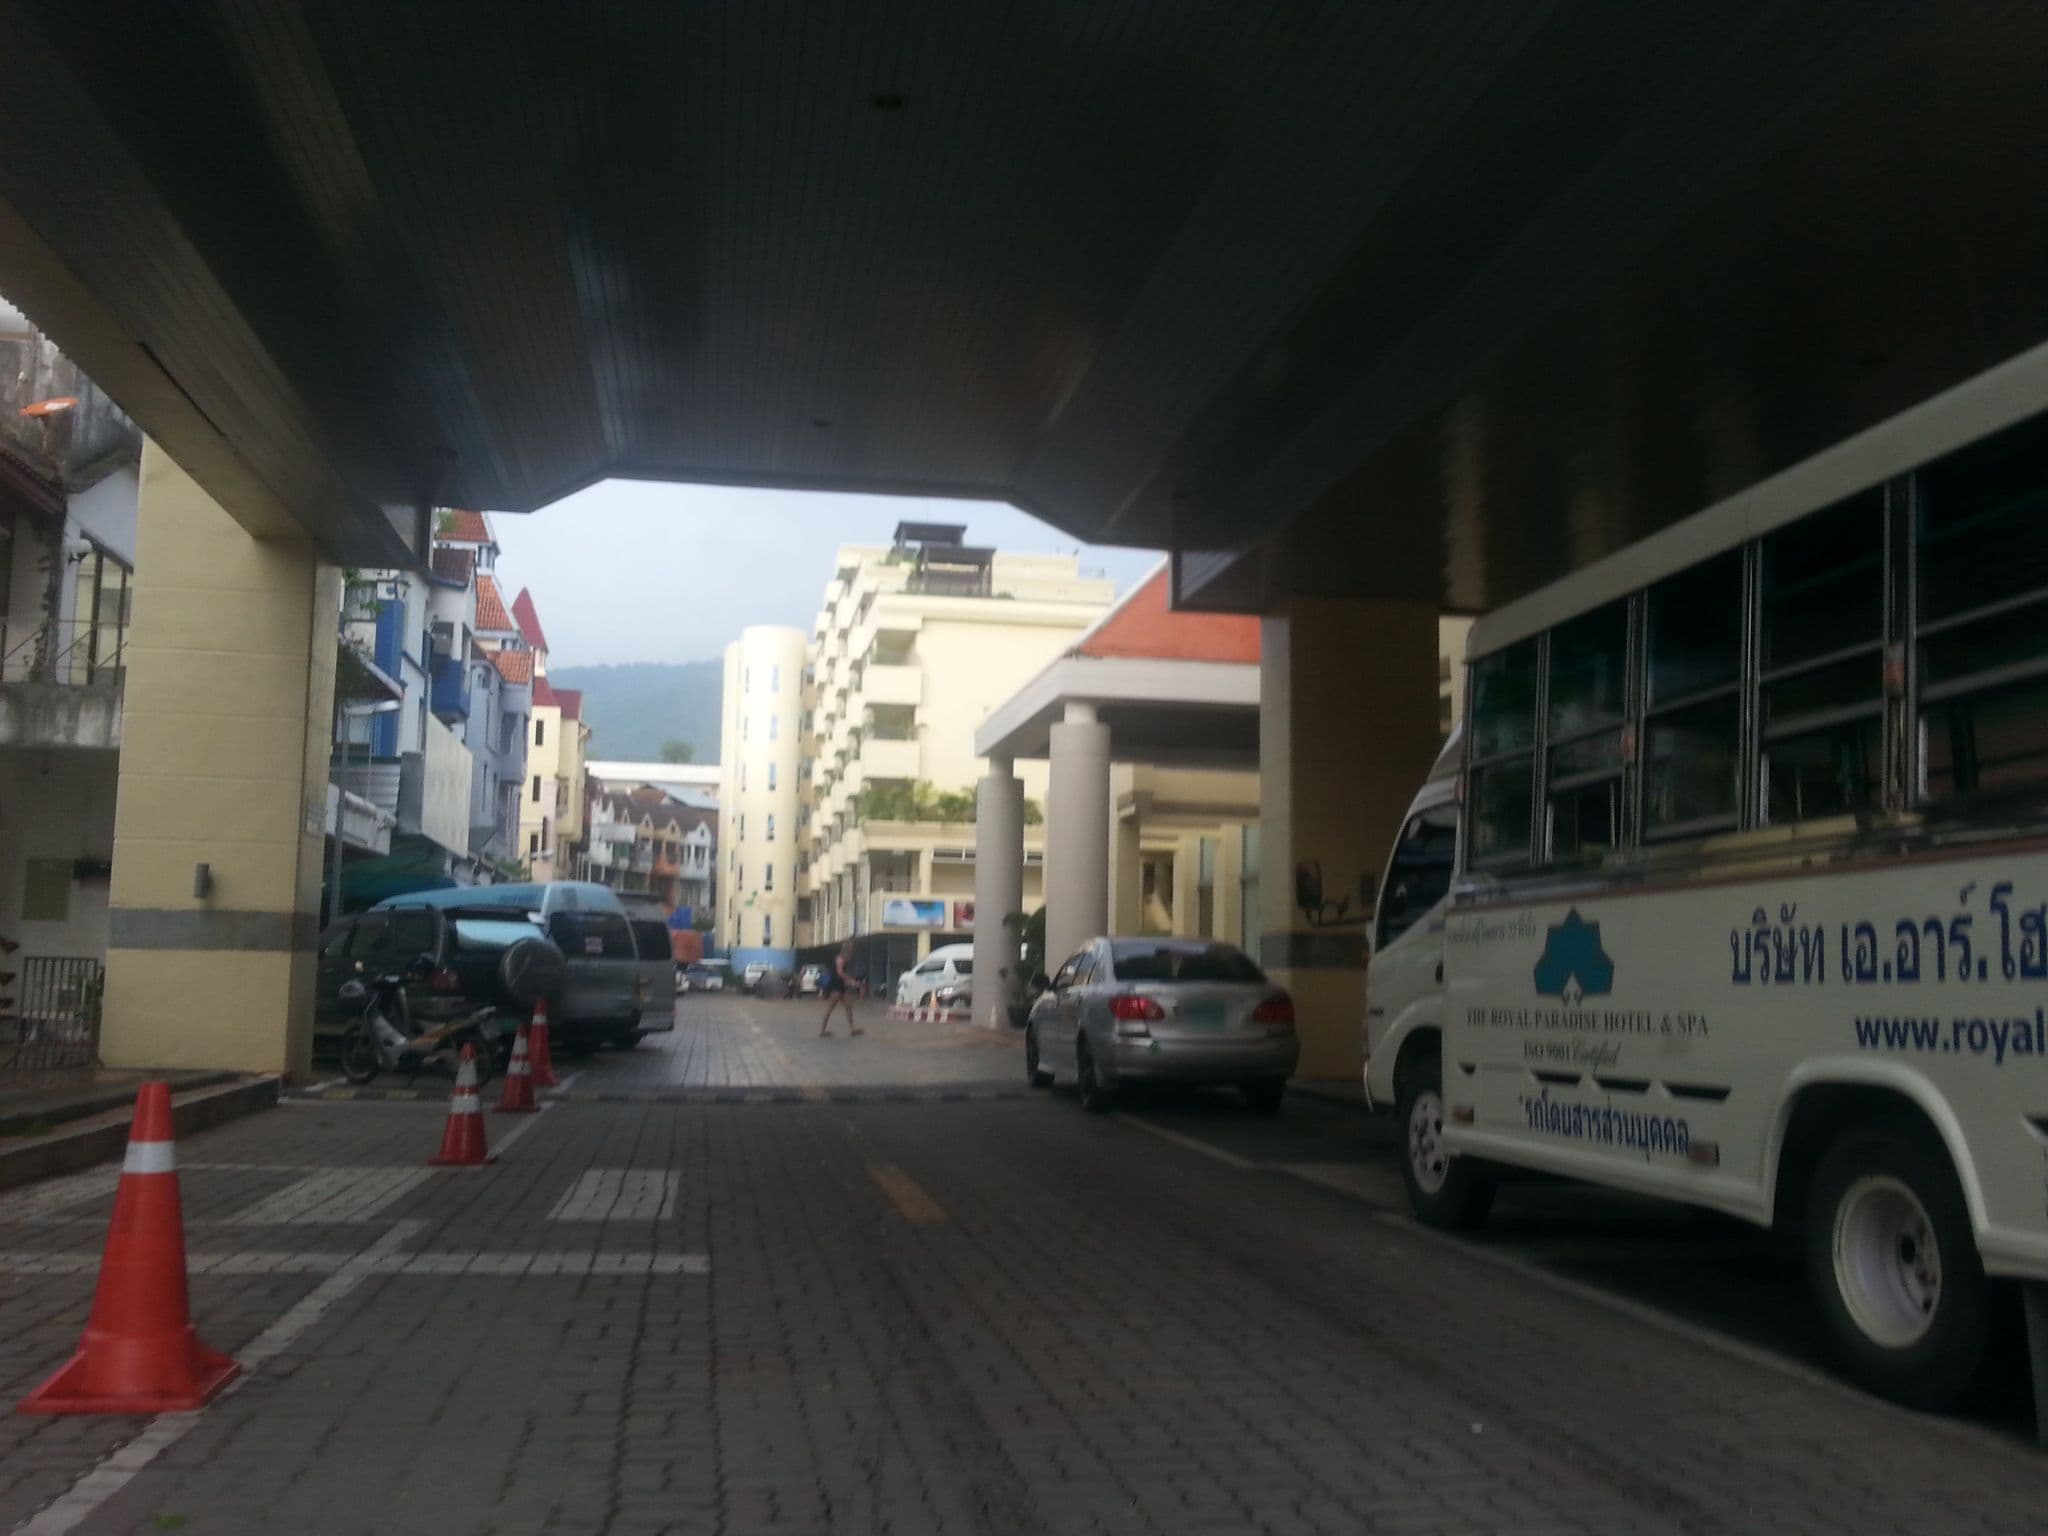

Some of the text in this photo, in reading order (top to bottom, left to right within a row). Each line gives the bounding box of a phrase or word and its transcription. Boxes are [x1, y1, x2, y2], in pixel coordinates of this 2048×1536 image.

[1730, 900, 1826, 986] บริษัท
[1467, 1007, 1709, 1037] THE ROYAL PARADISE HOTEL & SPA
[1855, 1006, 2048, 1066] www.royal
[1524, 1040, 1543, 1060] ISO
[1546, 1041, 1570, 1062] 9001
